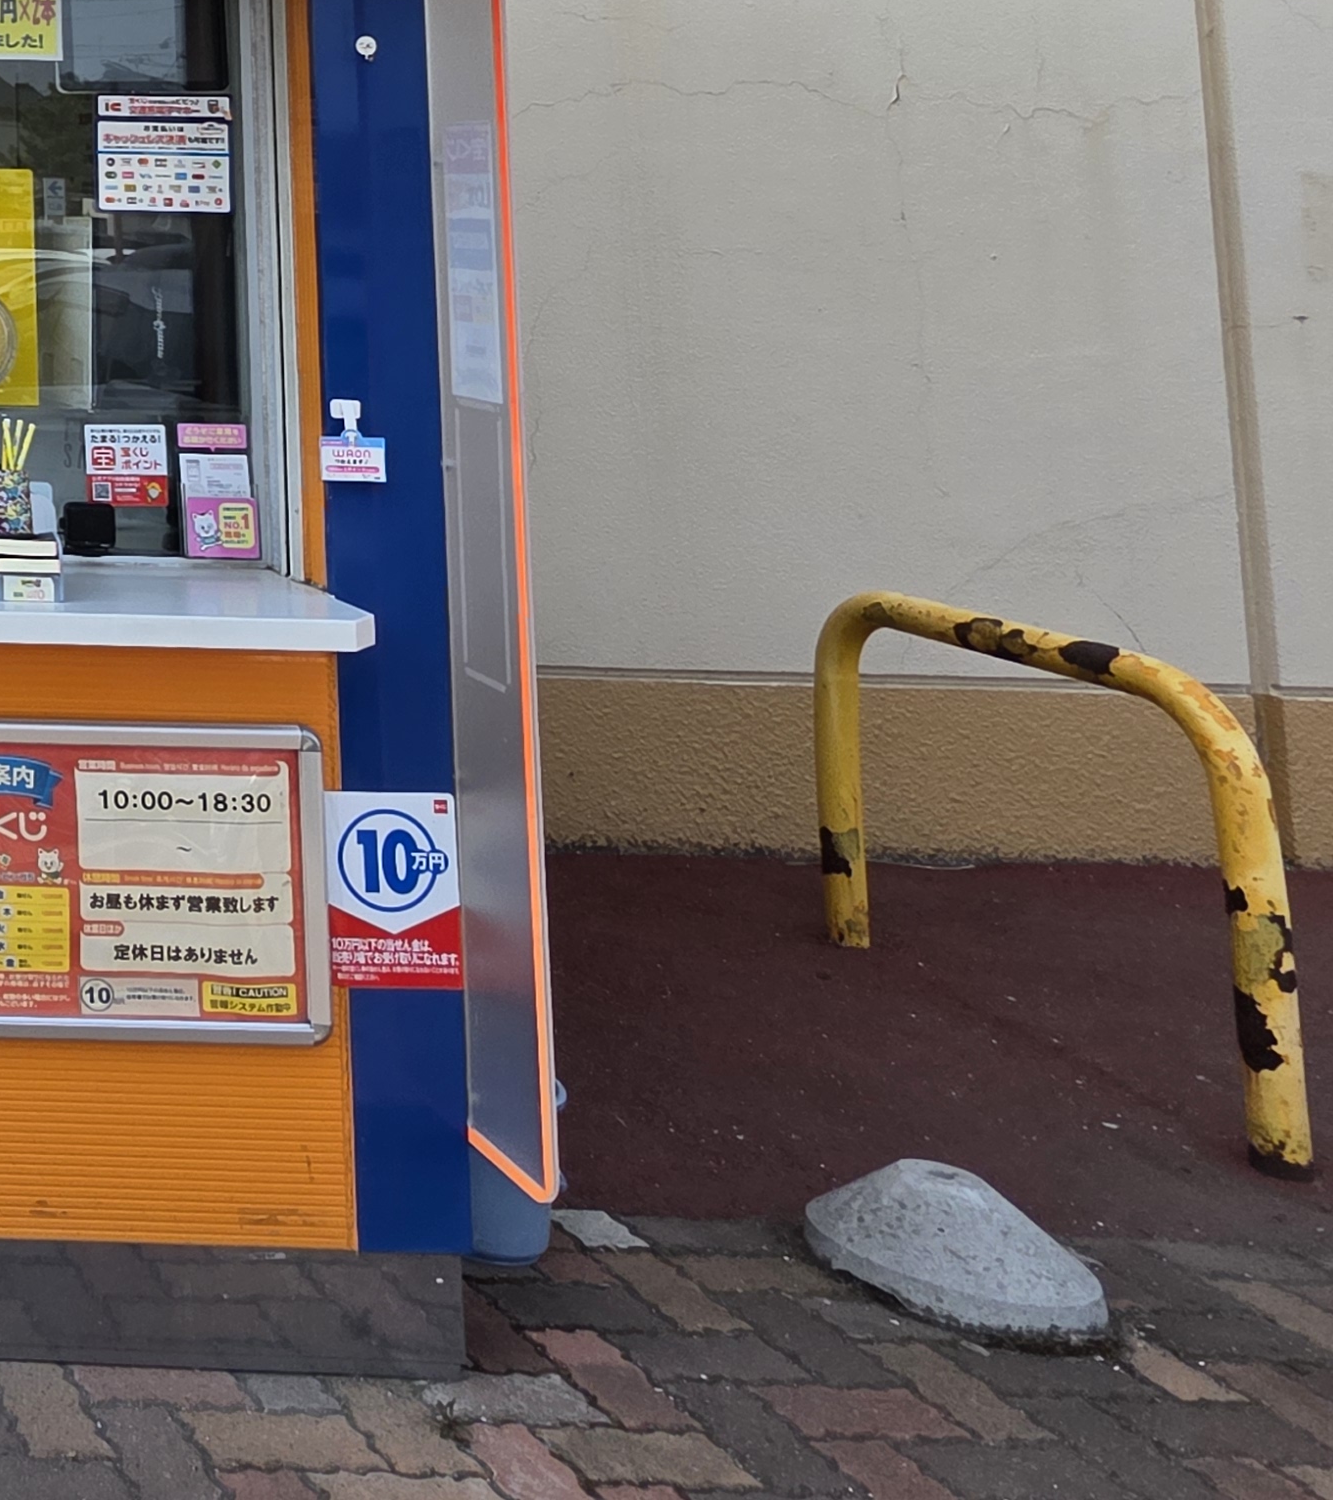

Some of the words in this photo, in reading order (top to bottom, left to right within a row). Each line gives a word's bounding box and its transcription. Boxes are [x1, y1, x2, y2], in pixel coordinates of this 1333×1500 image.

[120, 447, 149, 457] 宝くじ
[332, 449, 371, 458] WAON
[121, 459, 162, 470] ポイント
[356, 829, 419, 895] 10
[411, 851, 445, 871] 万円
[89, 892, 279, 914] お昼も休まず営業致します
[113, 944, 258, 965] 定休日はありません
[84, 986, 112, 1005] 10
[239, 987, 287, 998] CAUTION
